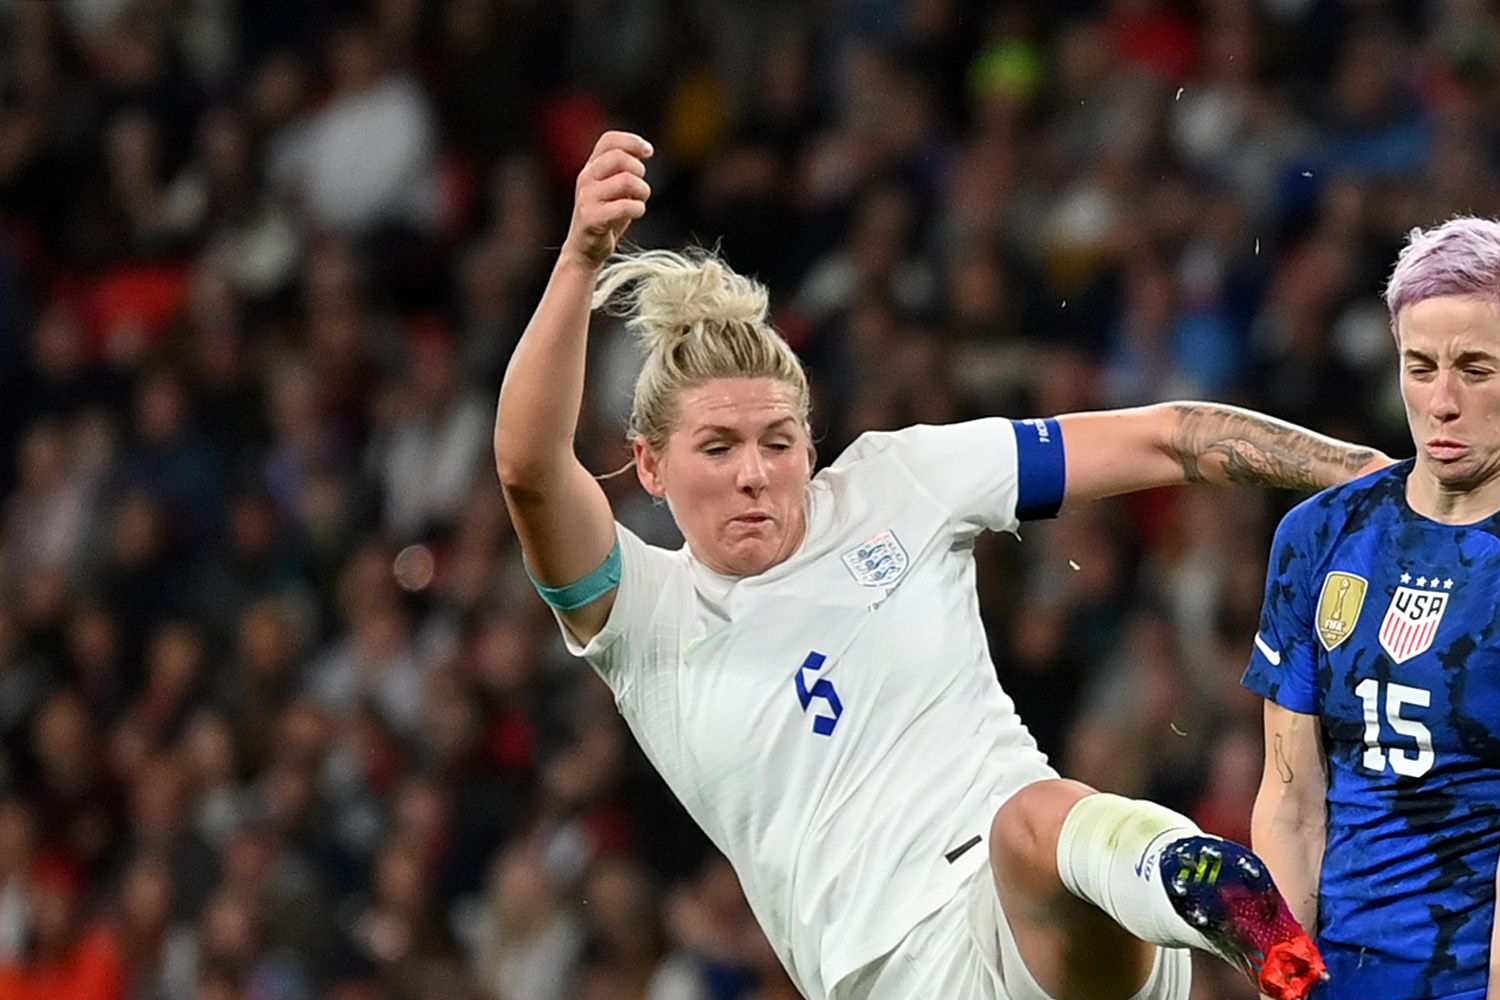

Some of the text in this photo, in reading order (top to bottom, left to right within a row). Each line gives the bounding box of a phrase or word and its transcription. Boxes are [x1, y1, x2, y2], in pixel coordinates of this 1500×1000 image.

[1324, 619, 1344, 631] FIFA
[1394, 591, 1444, 620] USA
[795, 650, 844, 738] 5
[1355, 678, 1435, 778] 15
